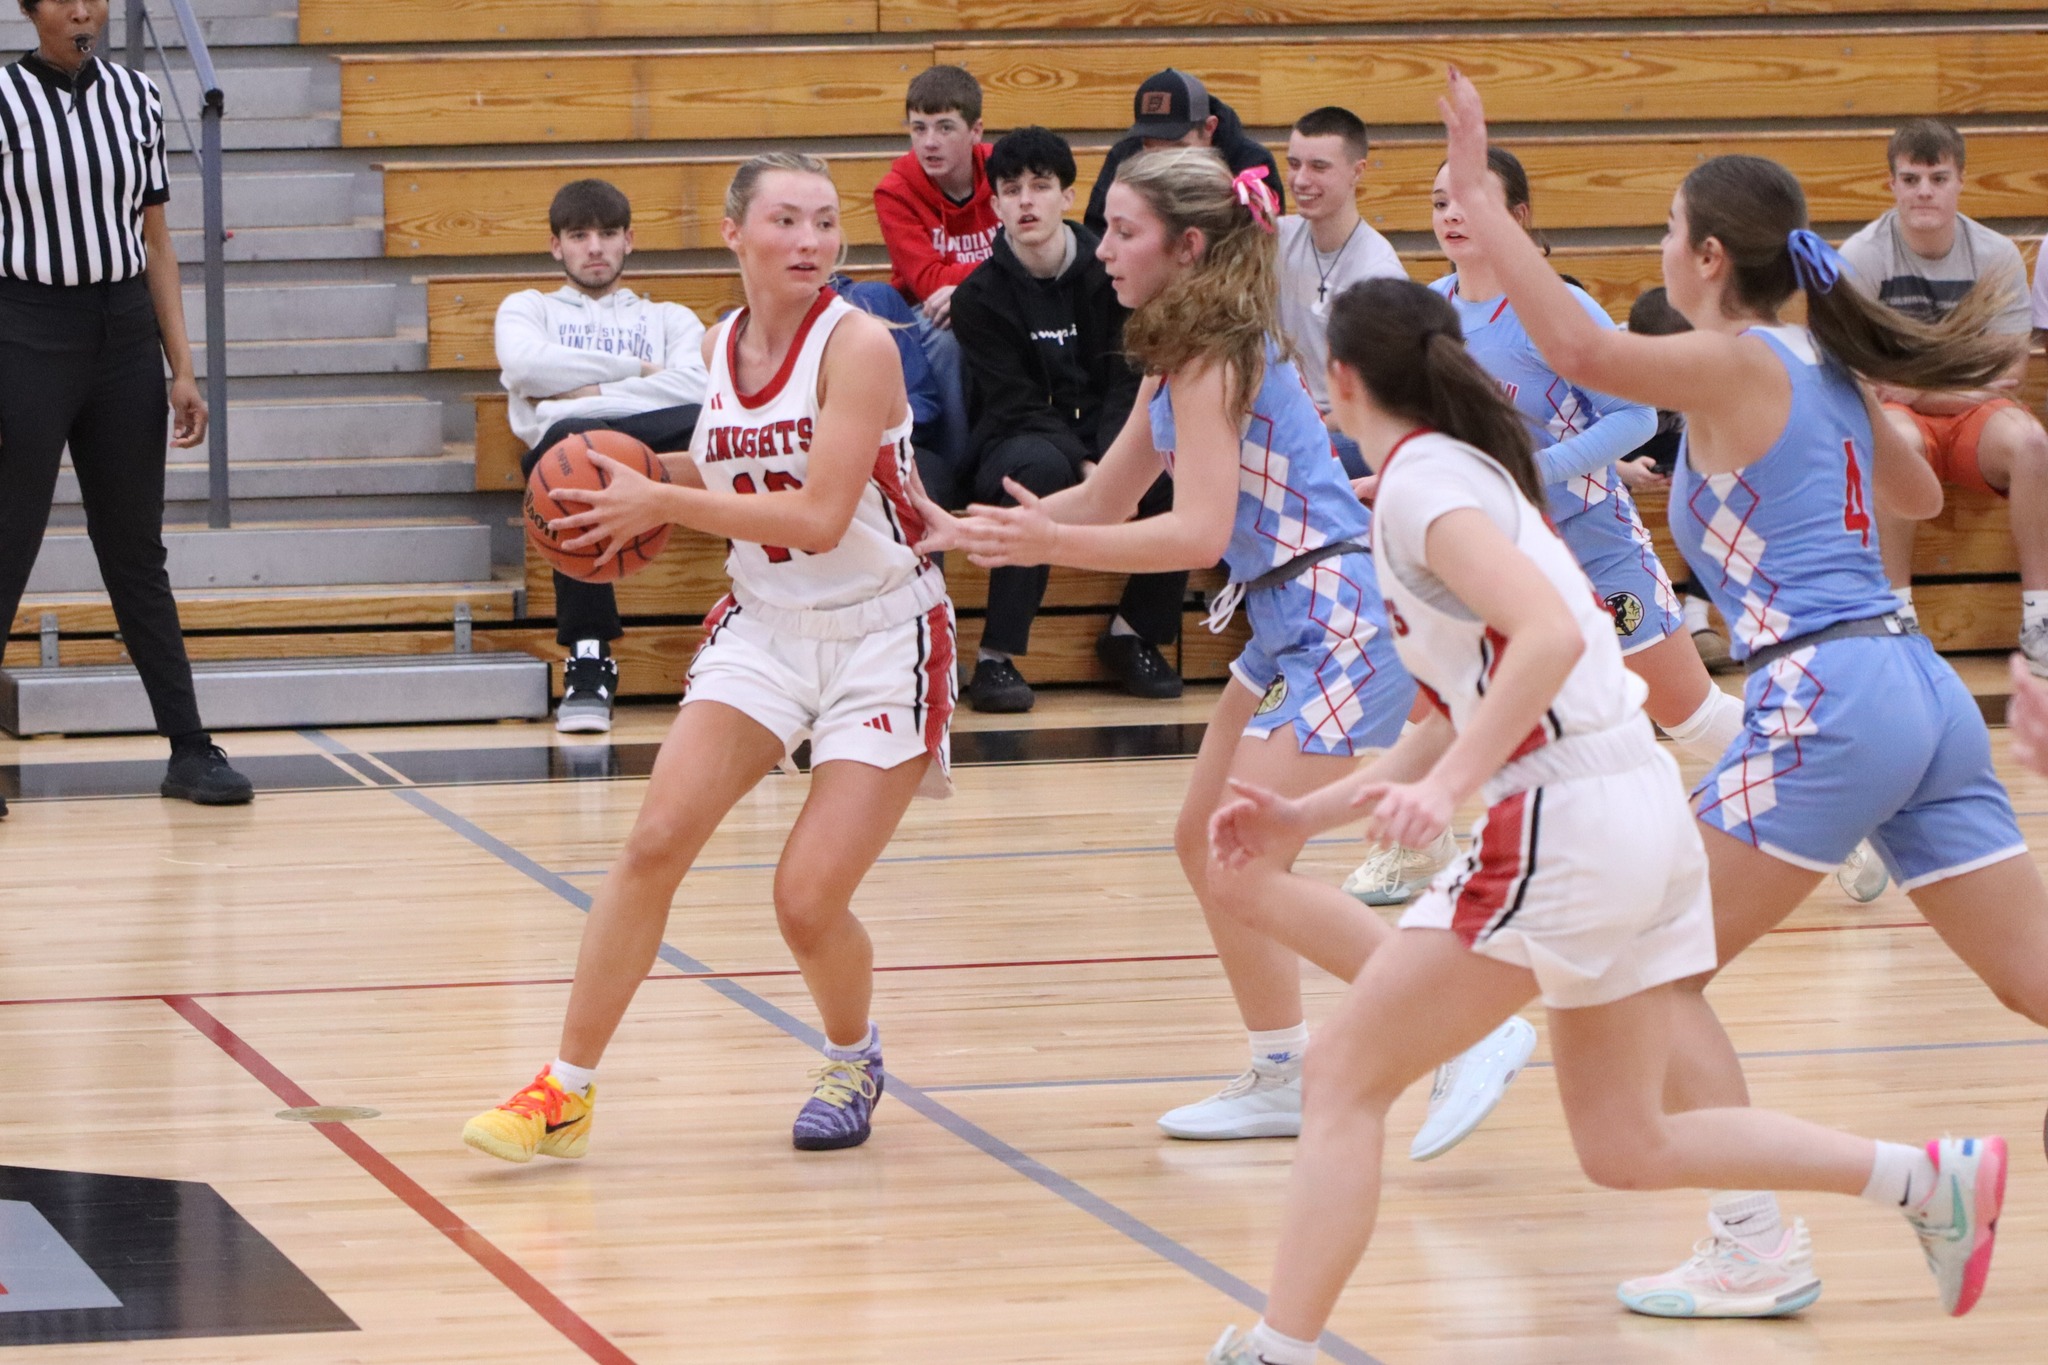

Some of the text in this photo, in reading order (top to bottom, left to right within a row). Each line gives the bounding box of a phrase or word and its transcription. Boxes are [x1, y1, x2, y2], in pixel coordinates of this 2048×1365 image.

[559, 323, 633, 337] UNIVSITY
[705, 417, 813, 463] KNIGHTS
[1843, 439, 1870, 549] 4
